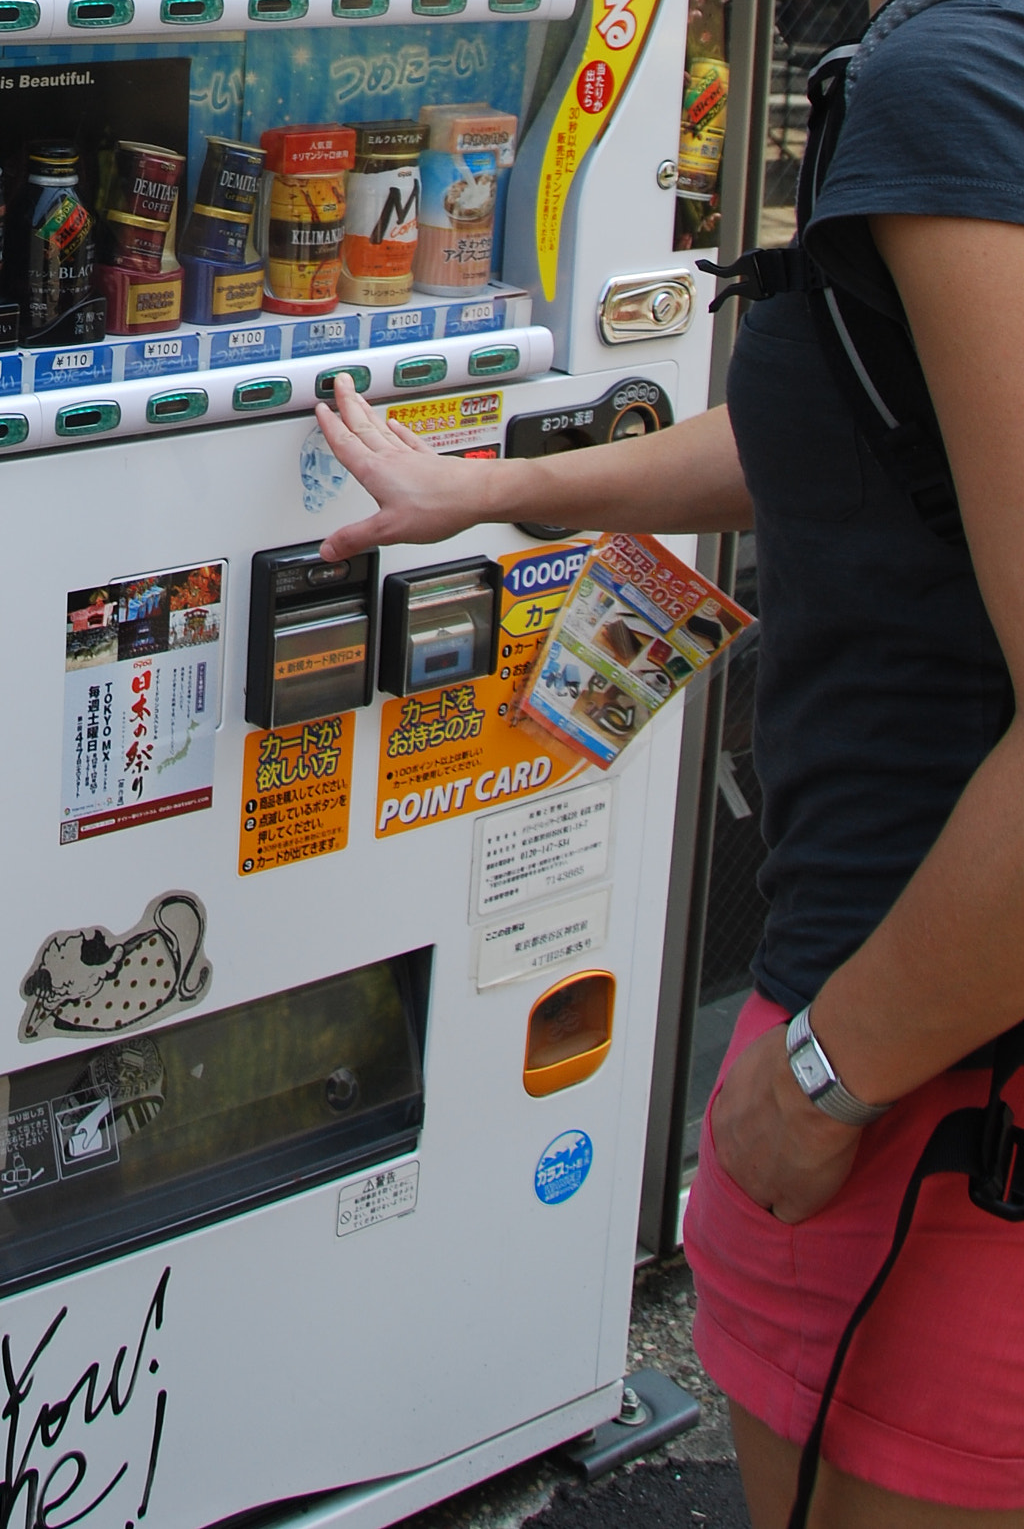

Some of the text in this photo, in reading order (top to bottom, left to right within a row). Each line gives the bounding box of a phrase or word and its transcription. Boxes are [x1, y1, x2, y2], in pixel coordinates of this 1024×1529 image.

[0, 76, 14, 90] is
[19, 71, 95, 88] Beautiful.
[584, 70, 595, 108] 出たら
[594, 63, 604, 112] 当たりが
[368, 133, 423, 145] ミルク&マイルド
[566, 107, 580, 173] 30秒以内に
[291, 150, 349, 162] キリマンジャロ使用
[391, 313, 419, 326] ¥100
[463, 306, 490, 319] ¥100
[148, 342, 179, 357] ¥100
[232, 331, 262, 345] ¥100
[56, 353, 87, 367] ¥110
[388, 402, 457, 419] 数字がそろえば
[541, 410, 594, 432] おつり・返却
[612, 534, 655, 573] CLUB
[86, 685, 100, 752] 毎週土曜日
[102, 682, 113, 762] TOKYO MX
[402, 684, 475, 728] カードを
[124, 669, 154, 801] 日本の祭り
[260, 719, 342, 761] カードが
[387, 711, 484, 758] お持ちの方
[257, 747, 341, 792] 欲しい方
[378, 777, 473, 831] POINT
[474, 754, 553, 806] CARD
[258, 795, 347, 828] 点滅しているボタンを
[375, 1170, 397, 1188] 警告
[537, 1163, 566, 1187] ガラス
